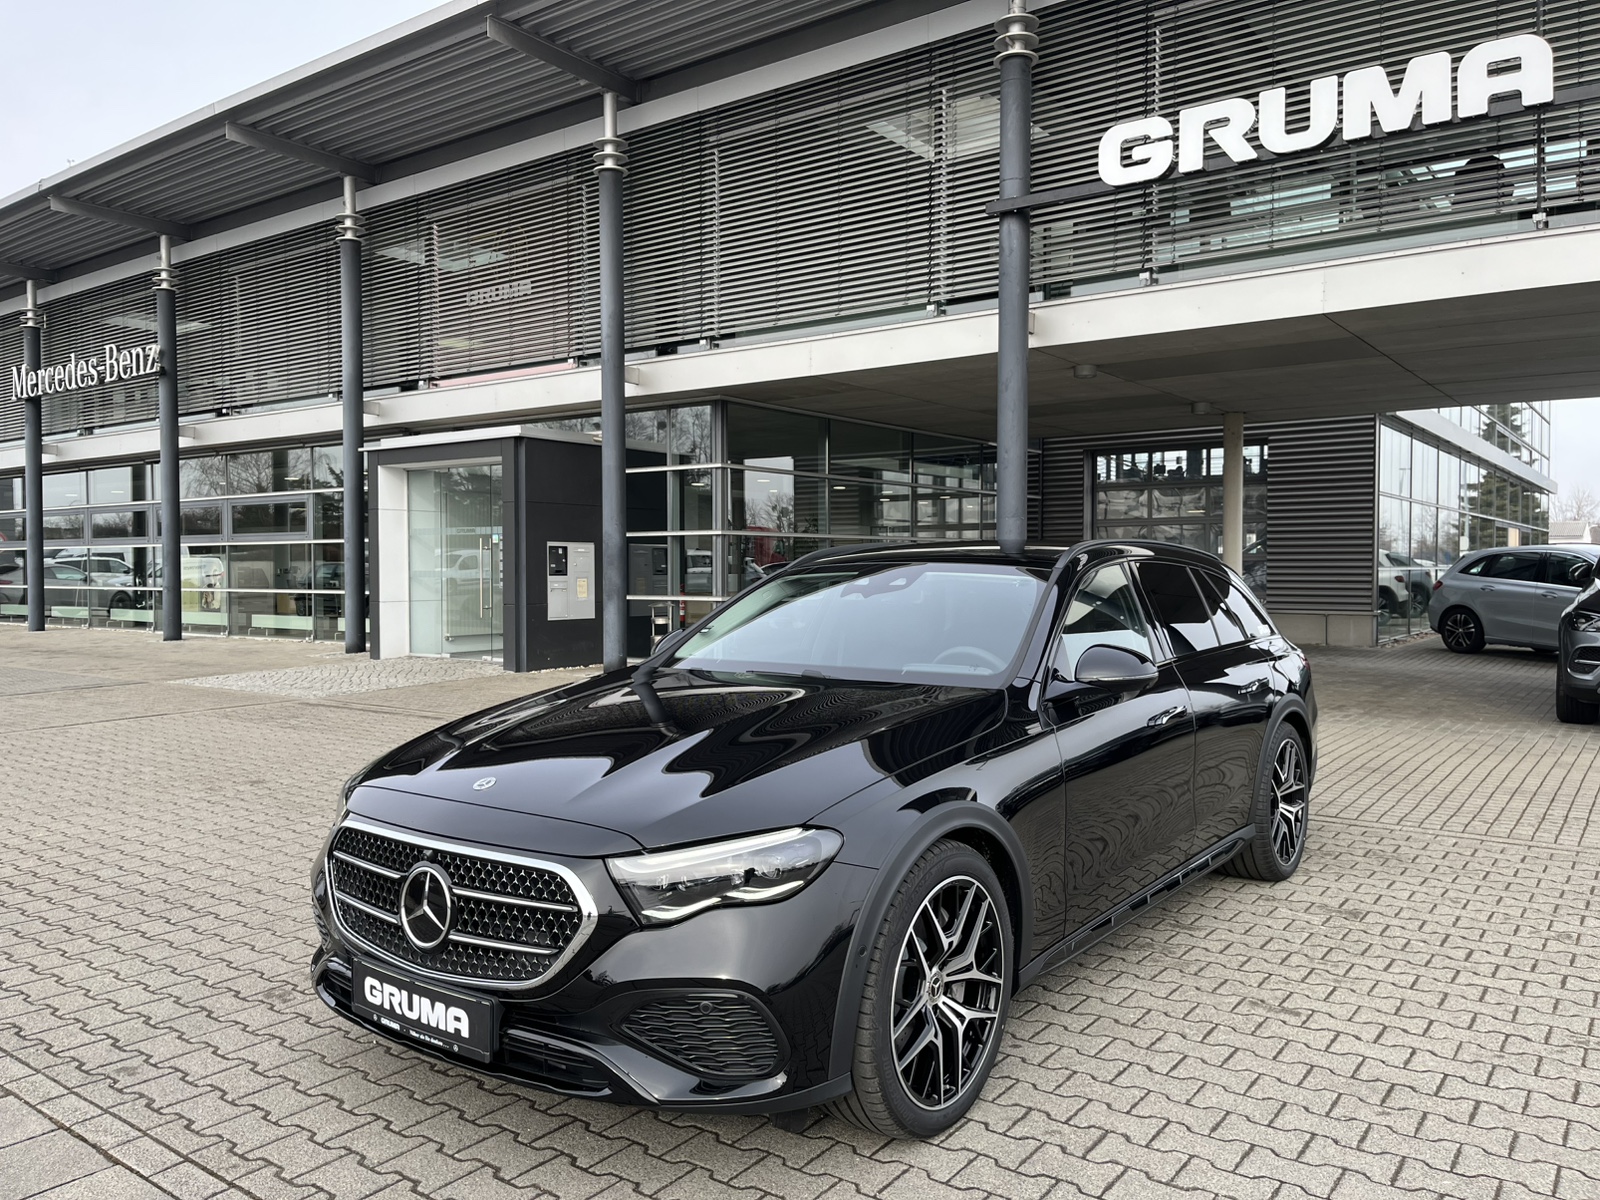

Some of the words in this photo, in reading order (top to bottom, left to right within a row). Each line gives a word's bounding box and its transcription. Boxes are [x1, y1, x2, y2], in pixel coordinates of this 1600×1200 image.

[1098, 33, 1554, 187] GRUMA
[11, 343, 160, 401] Mercedes-Benz
[364, 975, 470, 1039] GRUMA
